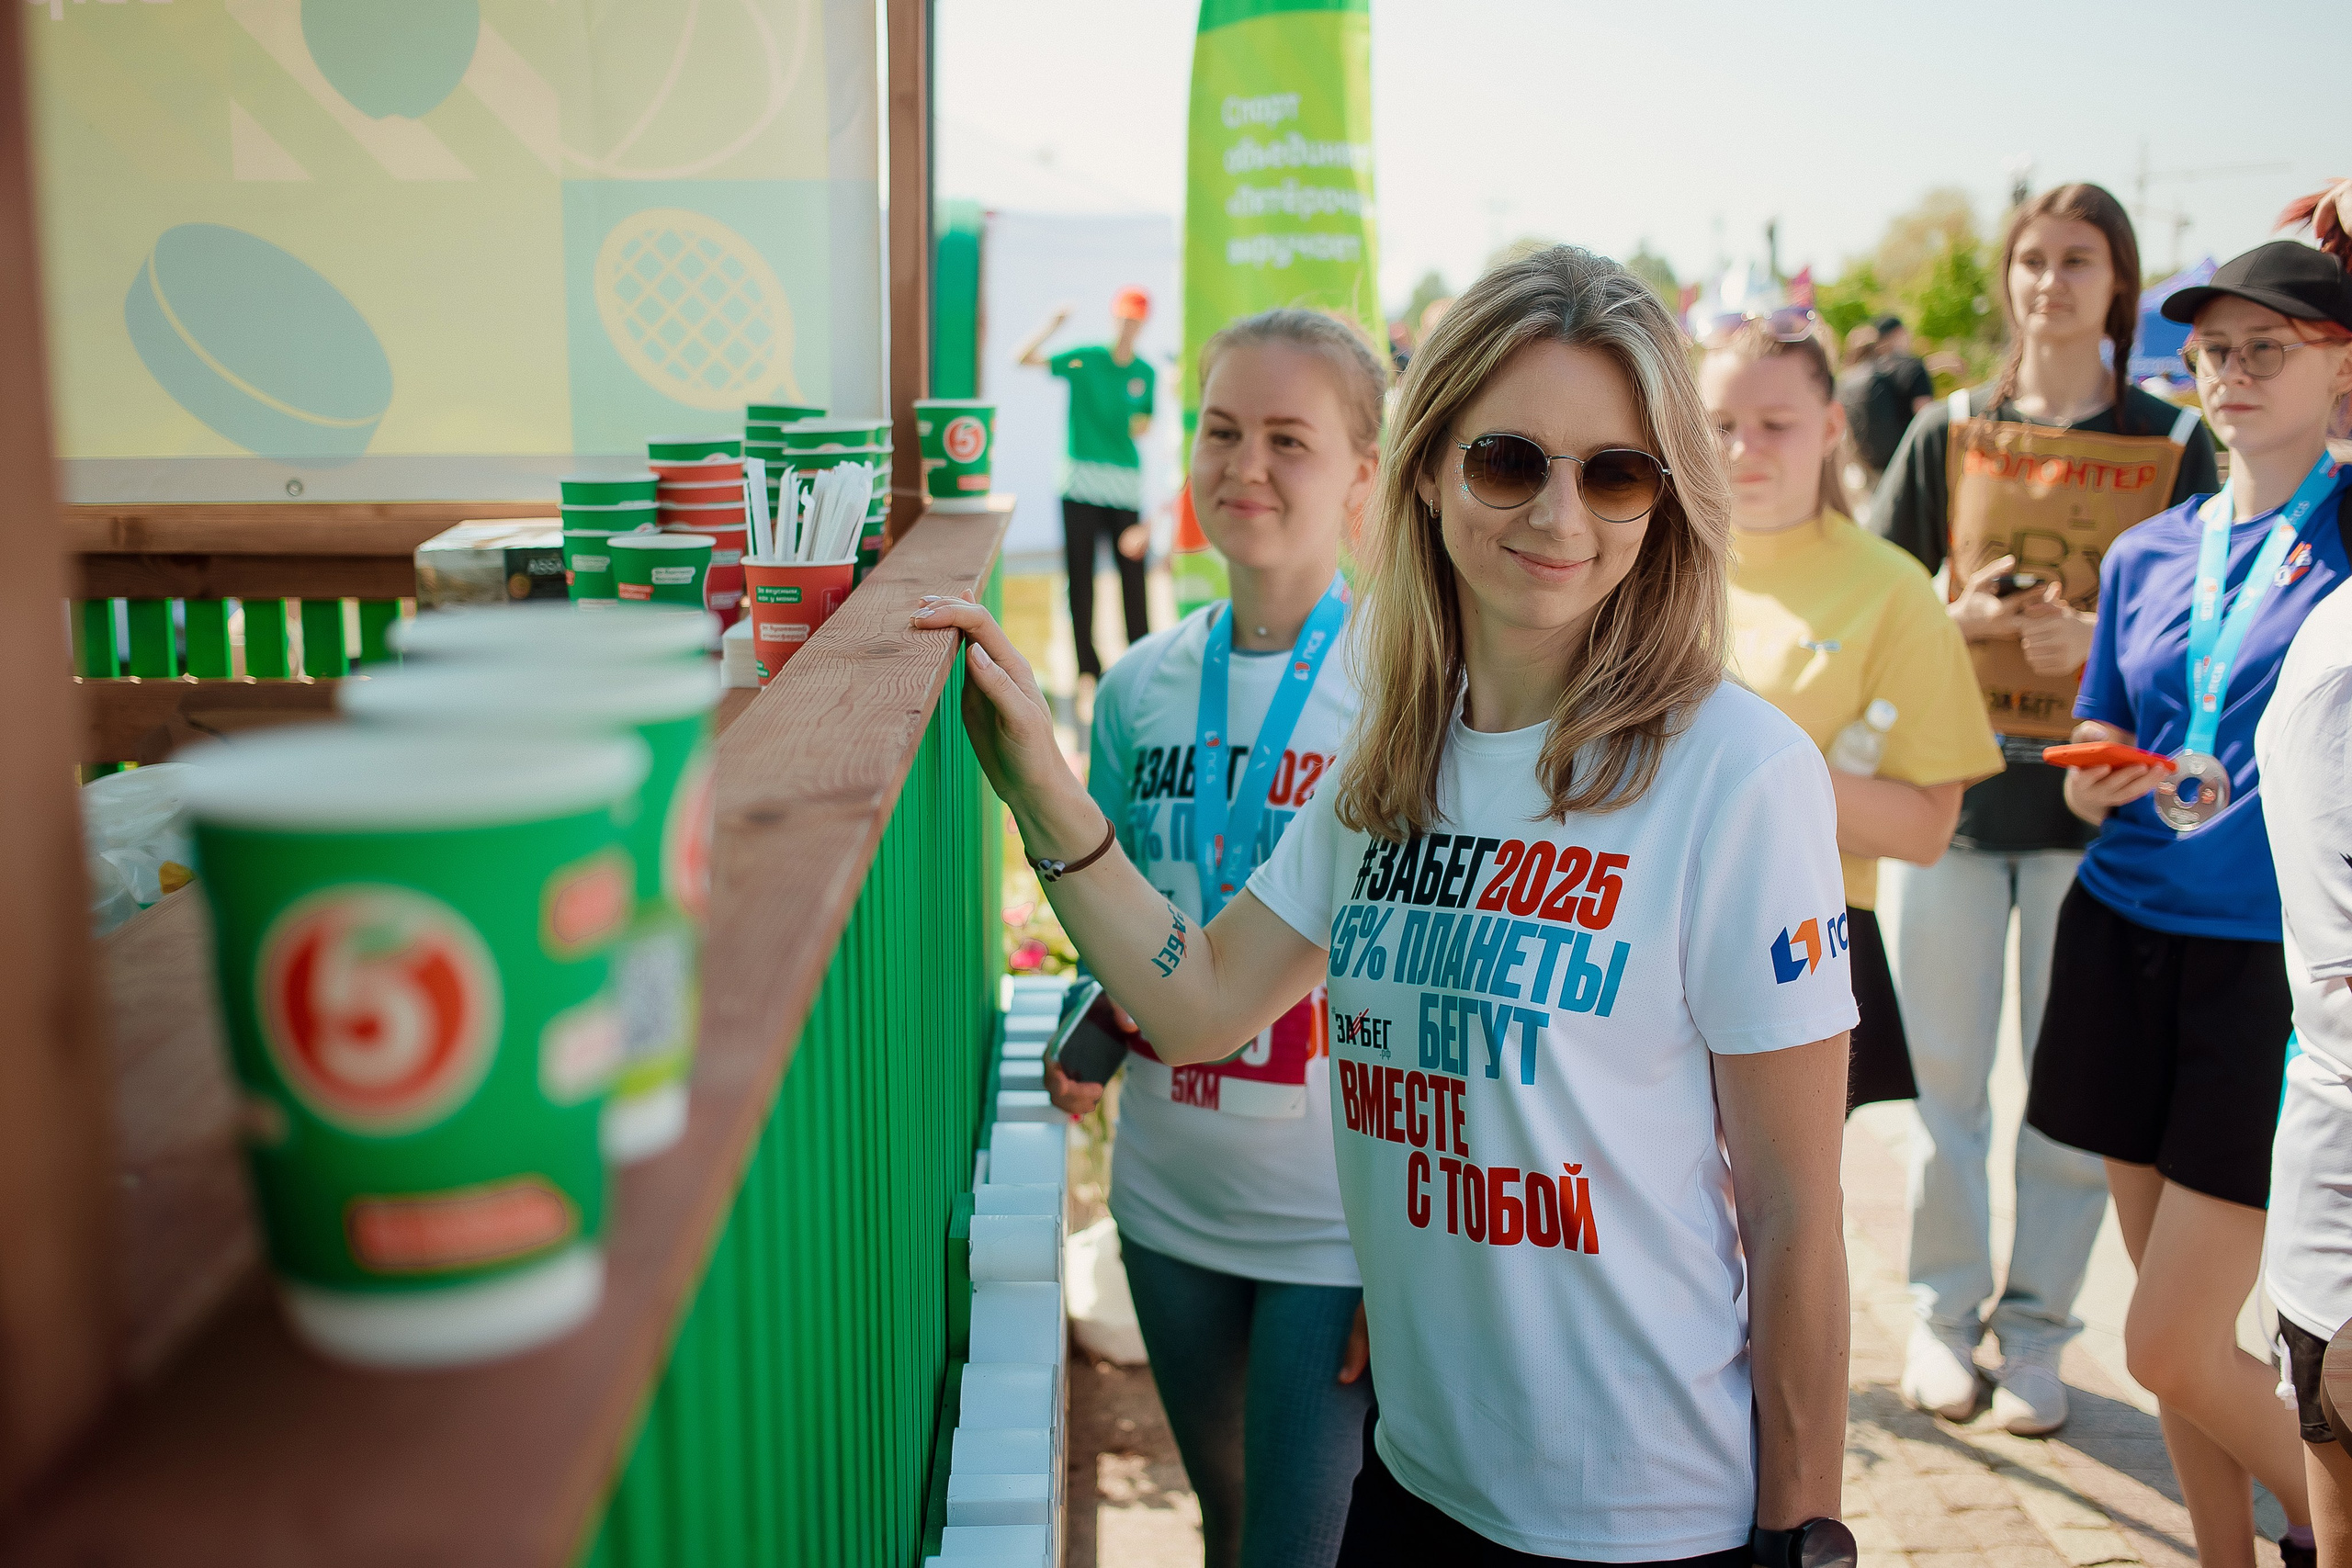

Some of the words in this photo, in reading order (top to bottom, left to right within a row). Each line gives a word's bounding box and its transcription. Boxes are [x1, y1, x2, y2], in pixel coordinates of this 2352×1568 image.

[1351, 832, 1631, 931] #ЗАБЕГ2025
[1393, 908, 1632, 1018] ПЛАНЕТЫ
[1419, 992, 1551, 1086] БЕГУТ
[1338, 1058, 1469, 1159] ВМЕСТЕ
[1408, 1150, 1431, 1229] С
[1439, 1162, 1600, 1255] ТОБОЙ
